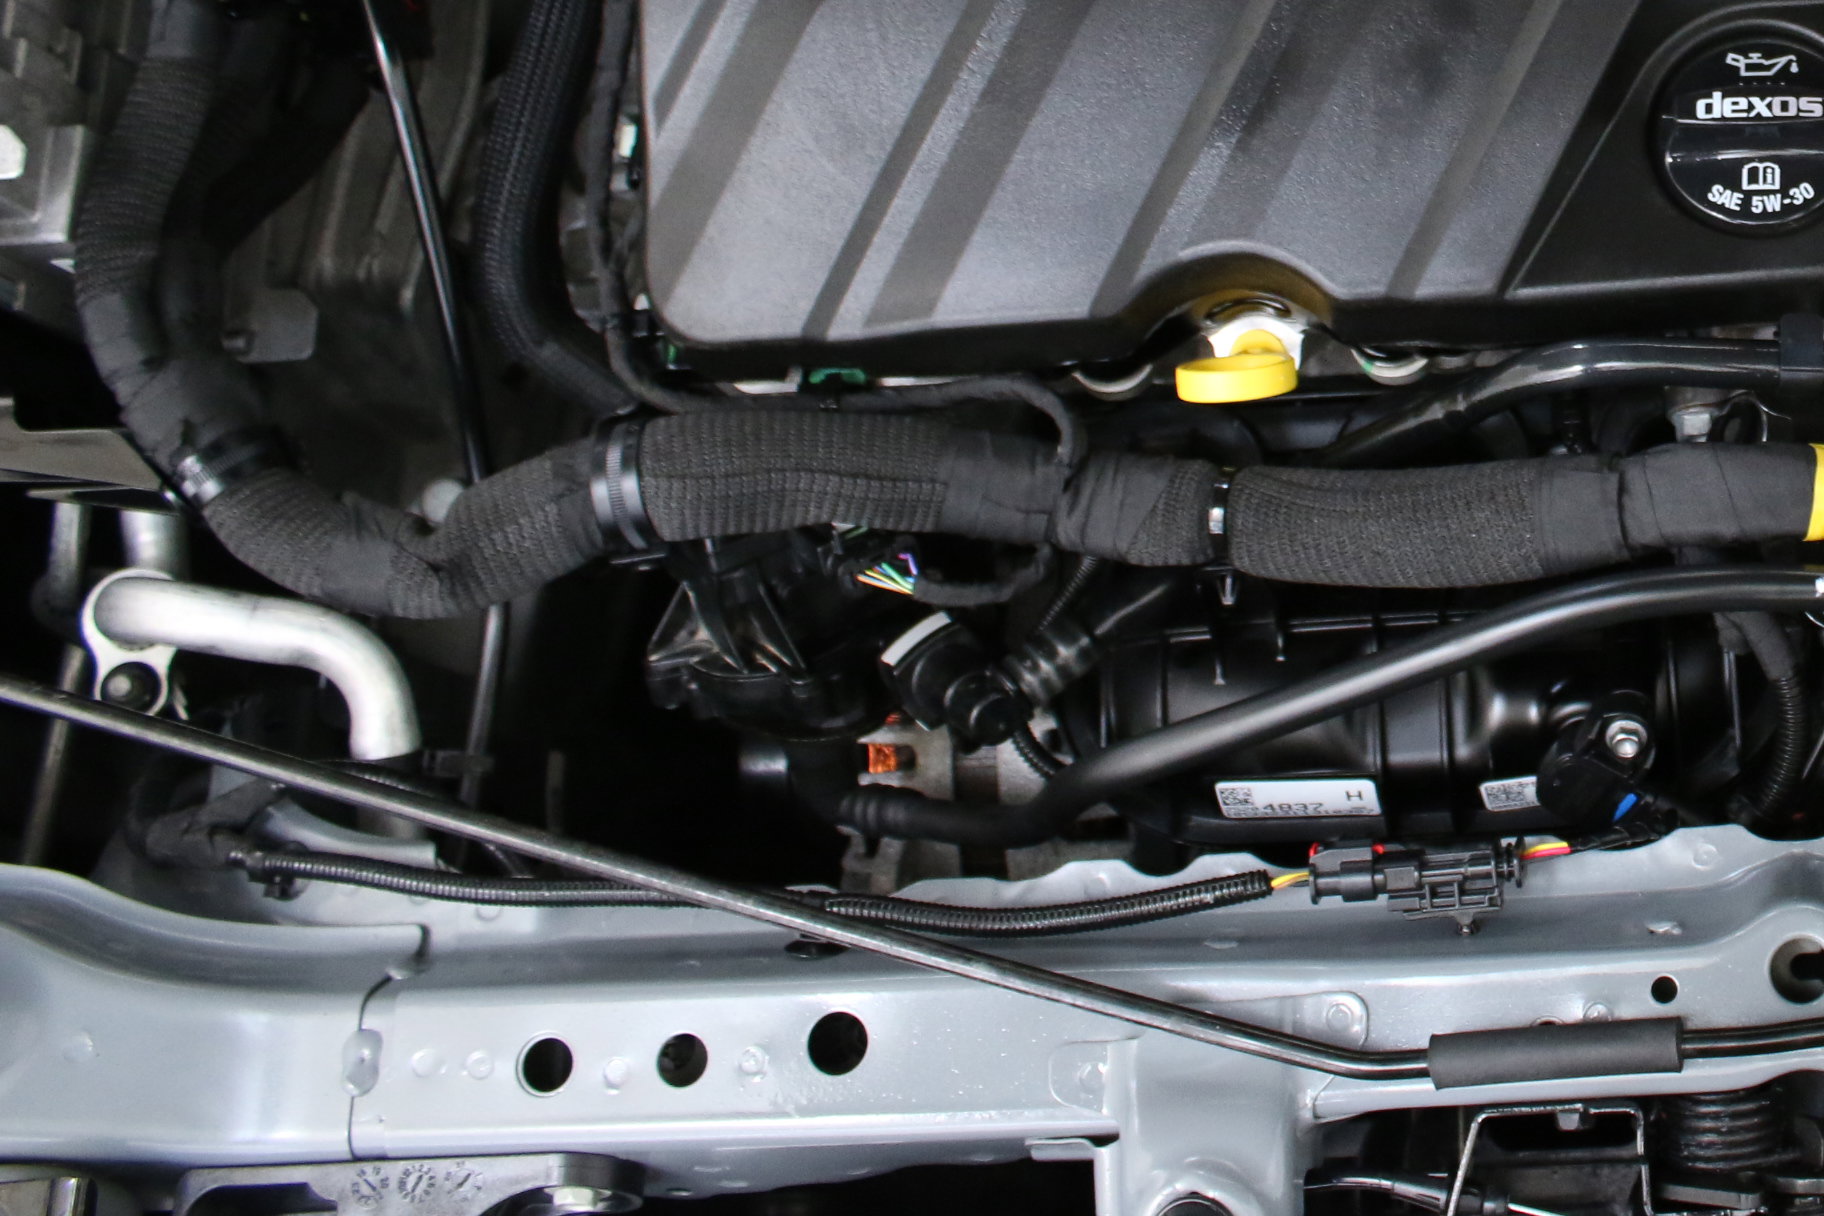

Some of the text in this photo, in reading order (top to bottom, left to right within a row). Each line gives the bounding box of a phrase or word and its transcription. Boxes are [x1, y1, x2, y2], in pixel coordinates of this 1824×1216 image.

[1695, 91, 1823, 119] dexos
[1707, 182, 1815, 214] SAE 5W-30
